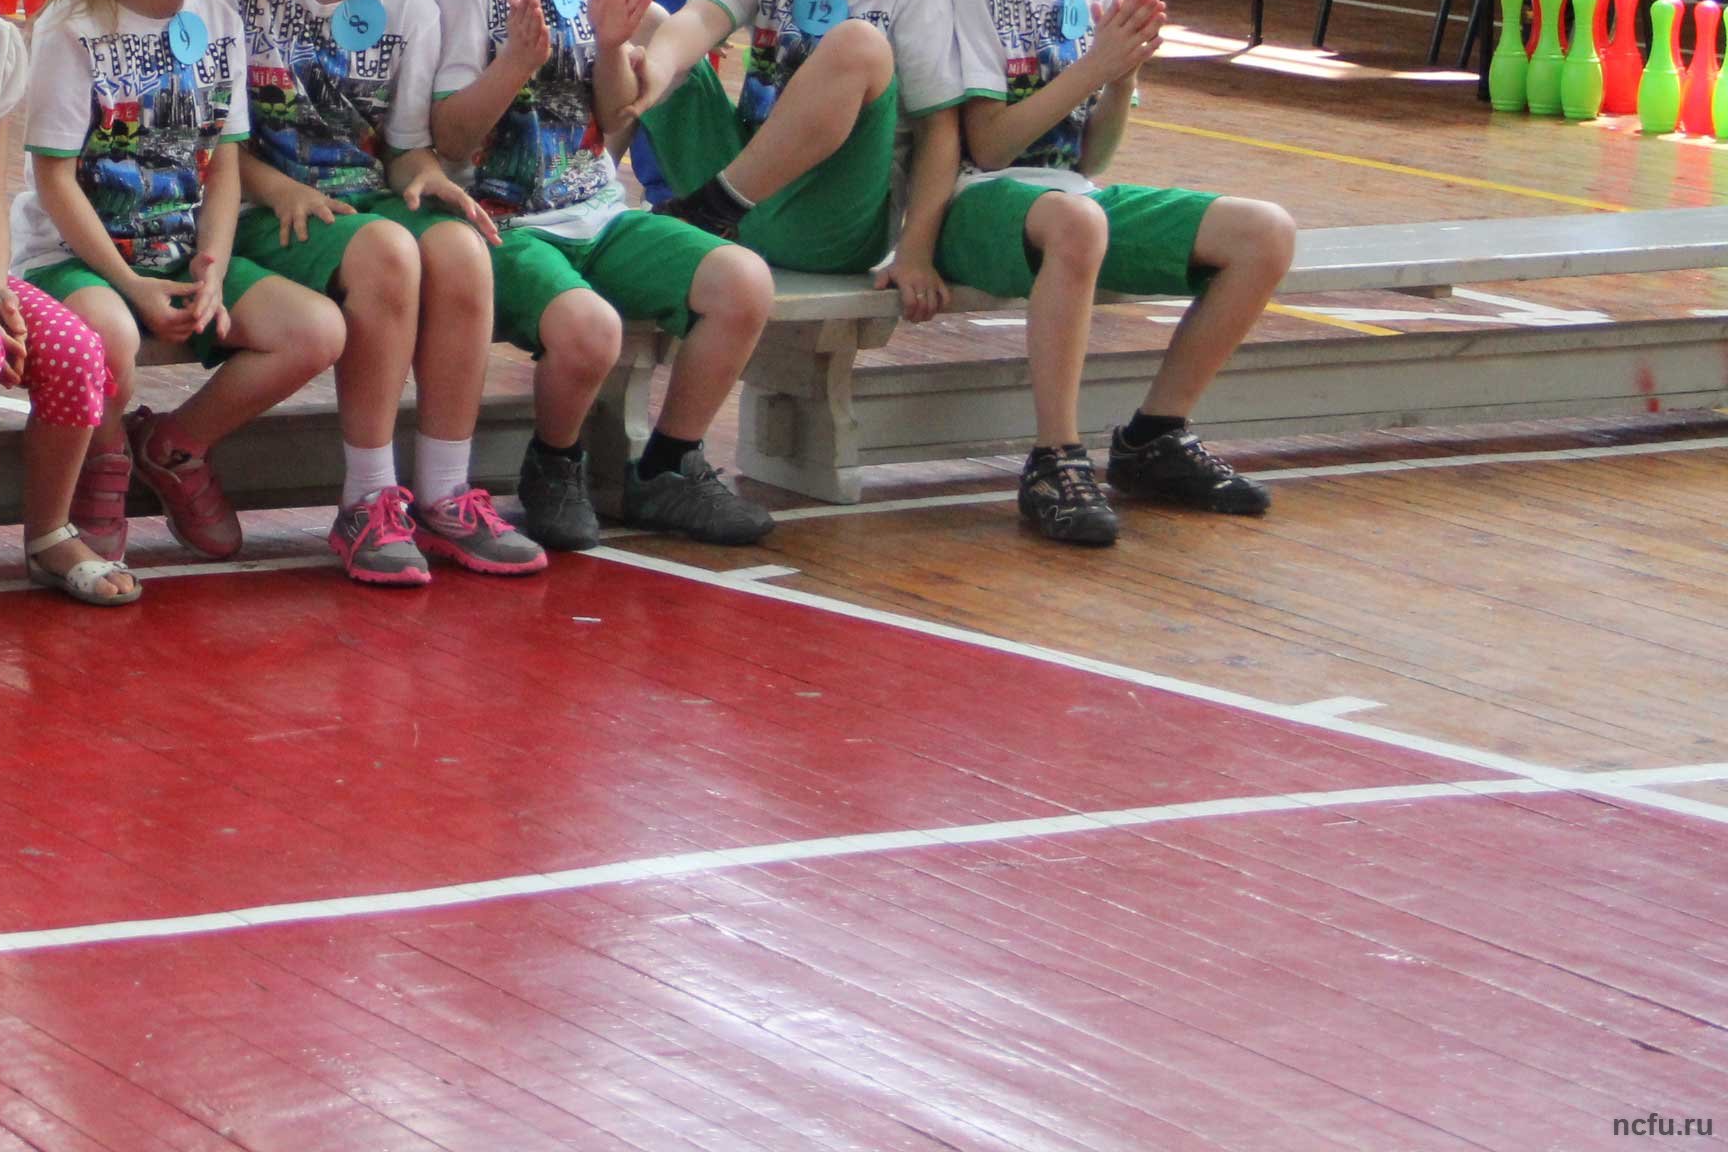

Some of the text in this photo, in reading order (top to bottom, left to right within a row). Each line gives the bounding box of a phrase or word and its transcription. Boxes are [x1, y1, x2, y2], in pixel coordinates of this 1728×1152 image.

[807, 0, 833, 24] 12
[1065, 5, 1079, 27] 10
[349, 14, 369, 34] 8
